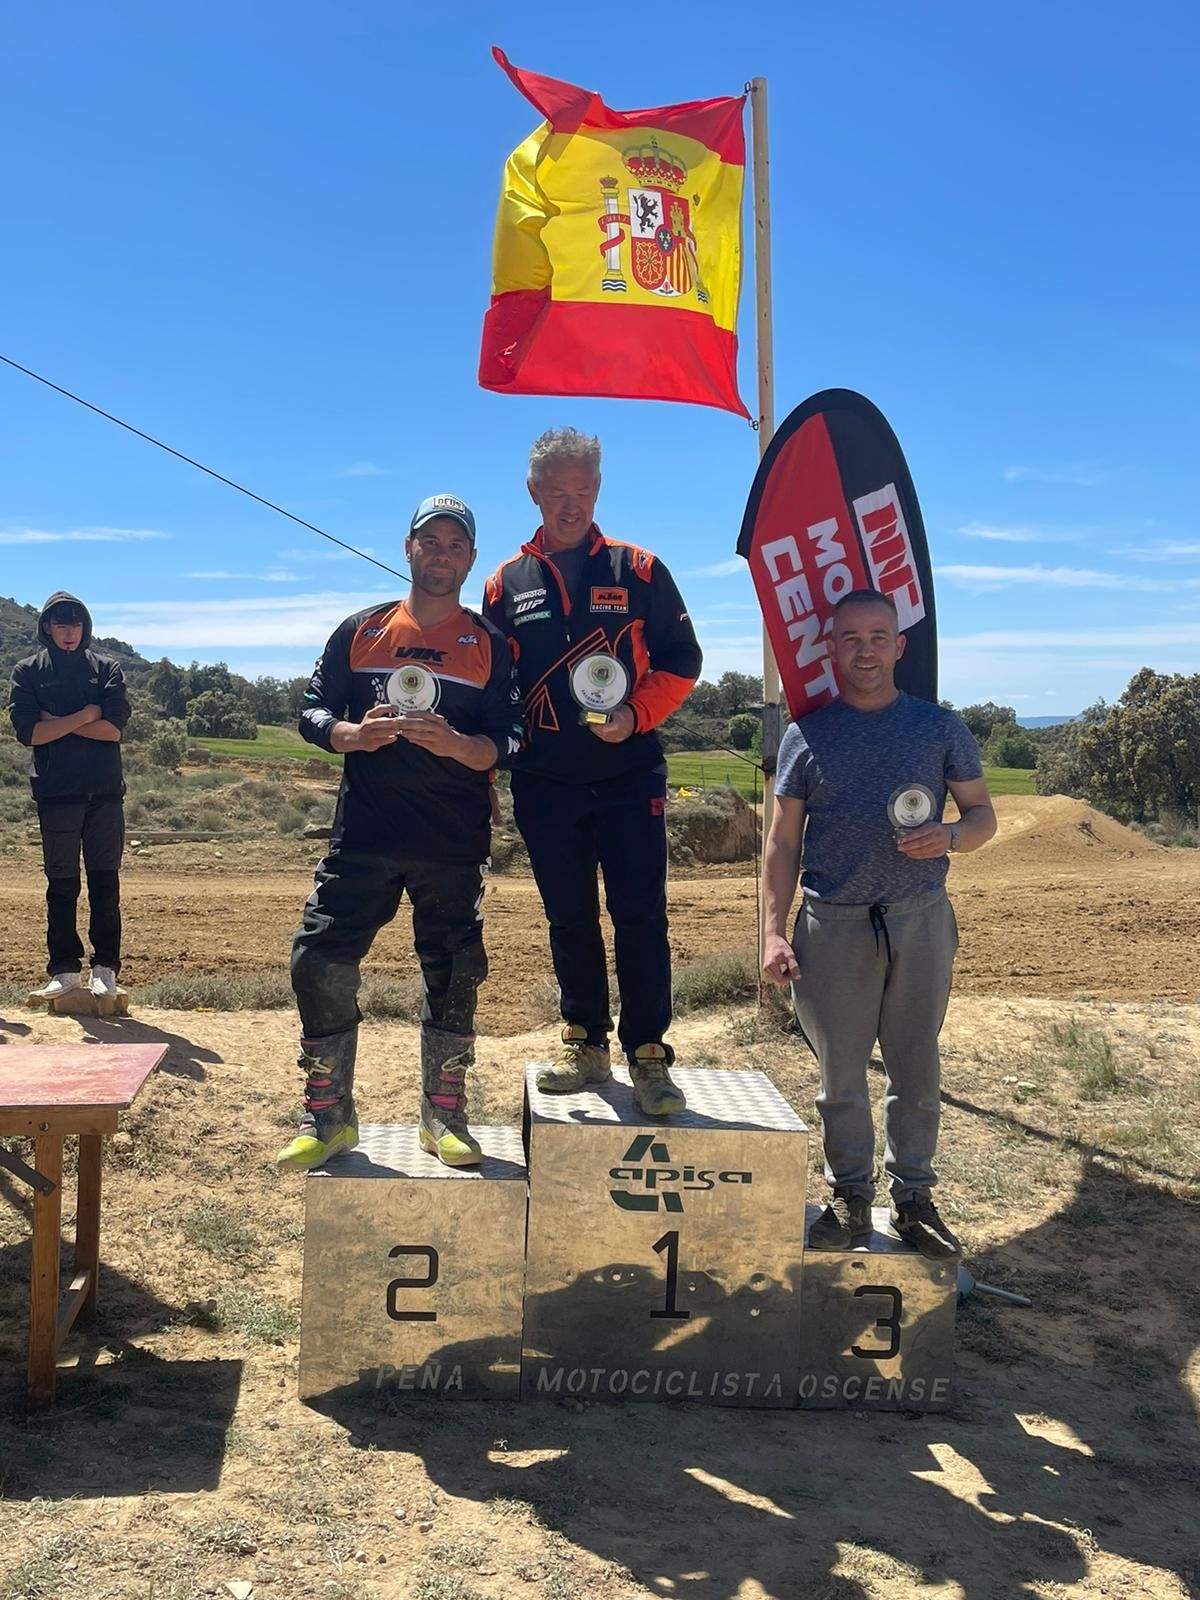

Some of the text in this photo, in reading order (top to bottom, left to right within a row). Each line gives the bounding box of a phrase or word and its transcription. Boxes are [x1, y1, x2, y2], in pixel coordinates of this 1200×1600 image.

[515, 599, 545, 614] WP
[591, 604, 628, 613] RACING TEAM
[608, 1165, 753, 1191] apisa
[387, 1244, 439, 1322] 2
[651, 1230, 691, 1319] 1
[851, 1284, 903, 1360] 3
[375, 1358, 951, 1401] PEÑA MOTOCICLISTA OSCENSE
